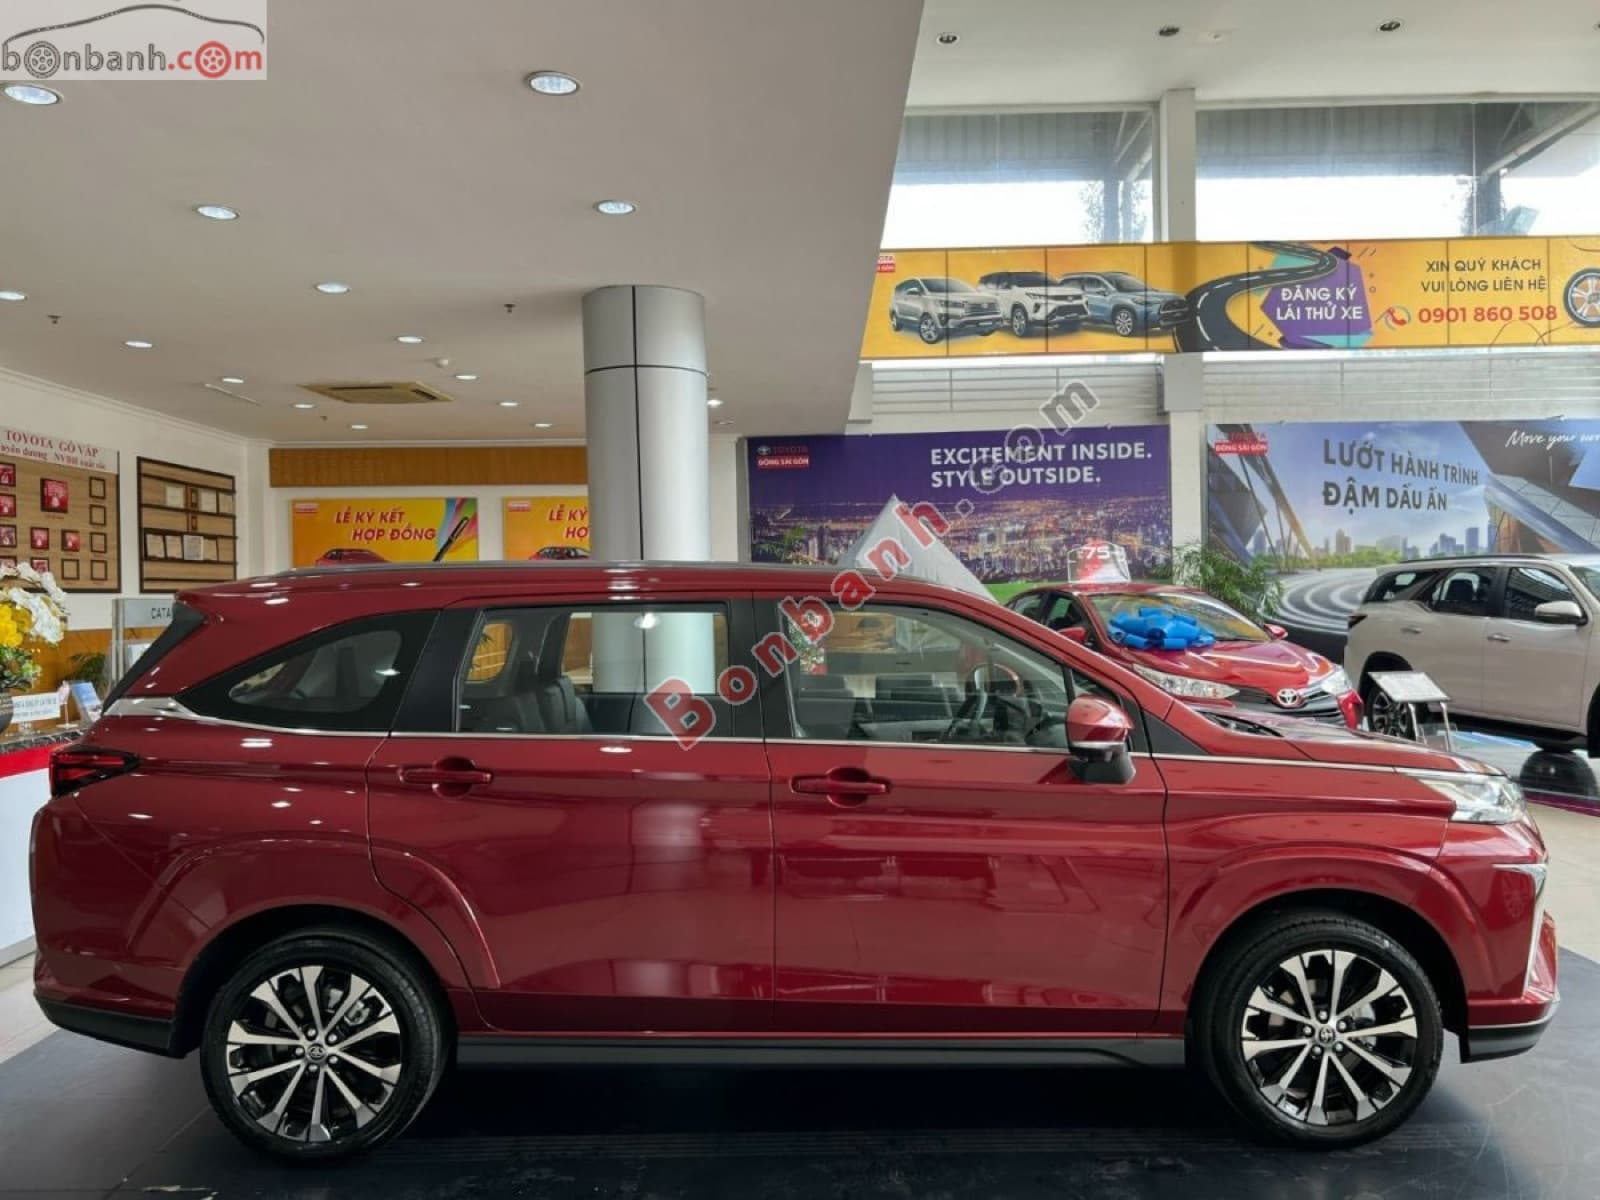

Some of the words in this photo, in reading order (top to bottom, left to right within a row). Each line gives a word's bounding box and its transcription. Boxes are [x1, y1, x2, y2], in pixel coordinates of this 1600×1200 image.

[1426, 261, 1449, 272] XIN
[1454, 257, 1486, 272] QUÝ
[1491, 257, 1541, 271] KHÁCH
[1281, 284, 1331, 301] ĐĂNG
[1335, 283, 1357, 300] KÝ
[1421, 281, 1445, 292] VUI
[1449, 277, 1489, 292] LÒNG
[1493, 276, 1524, 291] LIÊN
[1528, 275, 1547, 292] HỆ
[1276, 303, 1300, 320] LÁI
[1305, 301, 1337, 320] THỬ
[1341, 306, 1363, 320] XE
[1418, 307, 1467, 323] 0901
[1473, 306, 1513, 322] 860
[1519, 305, 1558, 321] 508
[7, 430, 53, 448] TOYOTA
[1505, 430, 1546, 448] Move
[931, 445, 1066, 465] EXCITEMENT
[1072, 442, 1153, 461] INSIDE.
[1323, 439, 1385, 472] LƯỚT
[1391, 451, 1439, 480] HÀNH
[1443, 463, 1478, 485] TRÌNH
[931, 470, 993, 488] STYLE
[1000, 466, 1101, 485] OUTSIDE.
[1322, 476, 1380, 515] ĐẬM
[1386, 482, 1422, 509] DẤU
[1427, 485, 1447, 510] ẤN
[355, 508, 375, 523] KÝ
[379, 506, 405, 523] KẾT
[352, 527, 385, 544] HỢP
[390, 522, 436, 541] ĐỒNG
